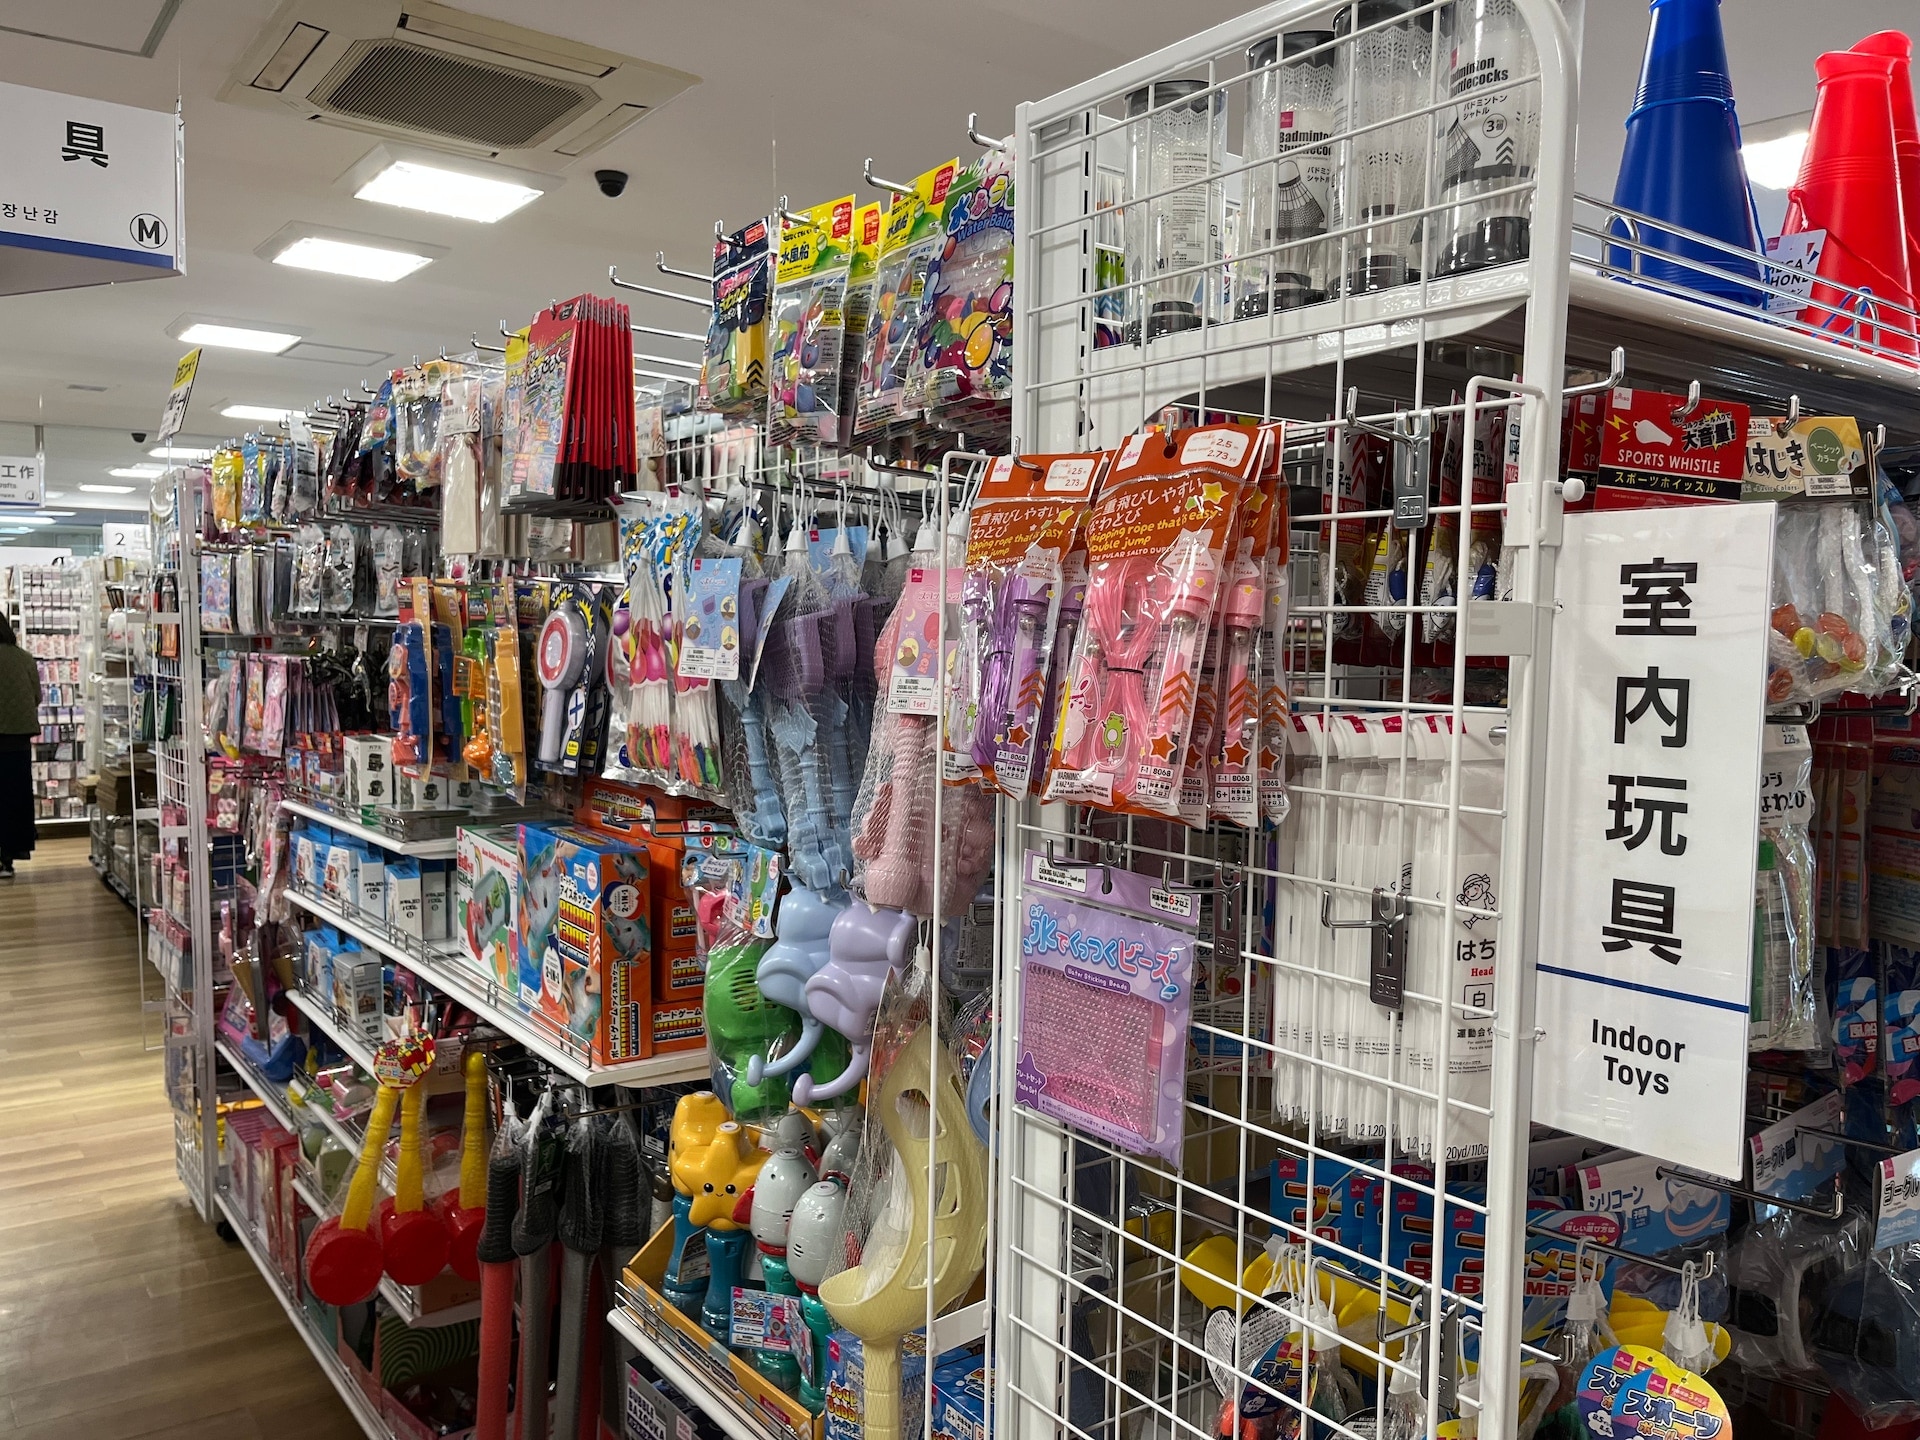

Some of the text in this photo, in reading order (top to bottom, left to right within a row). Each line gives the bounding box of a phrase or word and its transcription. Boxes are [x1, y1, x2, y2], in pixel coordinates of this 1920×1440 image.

[1463, 96, 1508, 111] バドミントン
[1463, 107, 1490, 120] シャトル
[62, 121, 108, 168] 具
[138, 218, 160, 245] M
[957, 219, 991, 242] Water
[780, 242, 809, 265] 水風船
[1216, 438, 1232, 448] 2.5
[1681, 420, 1737, 453] 大音量!
[1207, 451, 1228, 460] 2.73
[1810, 442, 1841, 454] ベーシック
[1617, 449, 1720, 474] SPORTS WHISTLE
[1816, 453, 1836, 463] カラー
[2, 465, 34, 479] 工作
[1072, 467, 1082, 475] 2.5
[1064, 479, 1080, 487] 2.73
[1615, 471, 1716, 494] スポーツホイッスル
[1092, 478, 1202, 519] 二重飛びしやすい
[1090, 507, 1143, 535] なわとび
[1127, 523, 1155, 535] rope
[1157, 517, 1181, 530] that
[1189, 509, 1218, 522] easy
[115, 533, 125, 545] 2
[1091, 535, 1151, 552] ouble jump
[1101, 551, 1125, 560] PULAR
[1126, 548, 1148, 557] SALTO
[913, 700, 926, 708] 1set
[1783, 734, 1795, 745] 2.29
[1010, 753, 1026, 761] 8068
[1601, 557, 1698, 966] 室内玩具
[995, 764, 1005, 772] 6+
[1152, 768, 1171, 777] 8068
[1137, 781, 1146, 790] 6+
[1183, 778, 1201, 786] 8068
[1216, 791, 1228, 799] 6+
[560, 885, 592, 910] アイスホッケー
[621, 888, 629, 913] 2-IN-1
[559, 899, 595, 933] BOARD
[559, 921, 590, 949] GAME
[1030, 914, 1178, 985] 水でくっつくビーズ
[1067, 969, 1128, 990] Water Sticking Beads
[1470, 966, 1494, 977] Head
[1472, 991, 1486, 1008] 白
[654, 1008, 701, 1021] ボードゲーム
[1591, 1018, 1686, 1064] Indoor
[1016, 1069, 1043, 1085] プレートセット
[1603, 1055, 1670, 1096] Toys
[1017, 1082, 1037, 1096] Plate Set
[1755, 1143, 1786, 1180] ゴーグル
[1590, 1185, 1644, 1212] シリコーン
[1564, 1225, 1616, 1233] 詳しい遊び方は
[830, 1381, 857, 1404] Soap
[947, 1408, 956, 1422] 6+
[1622, 1389, 1722, 1438] スポーツ
